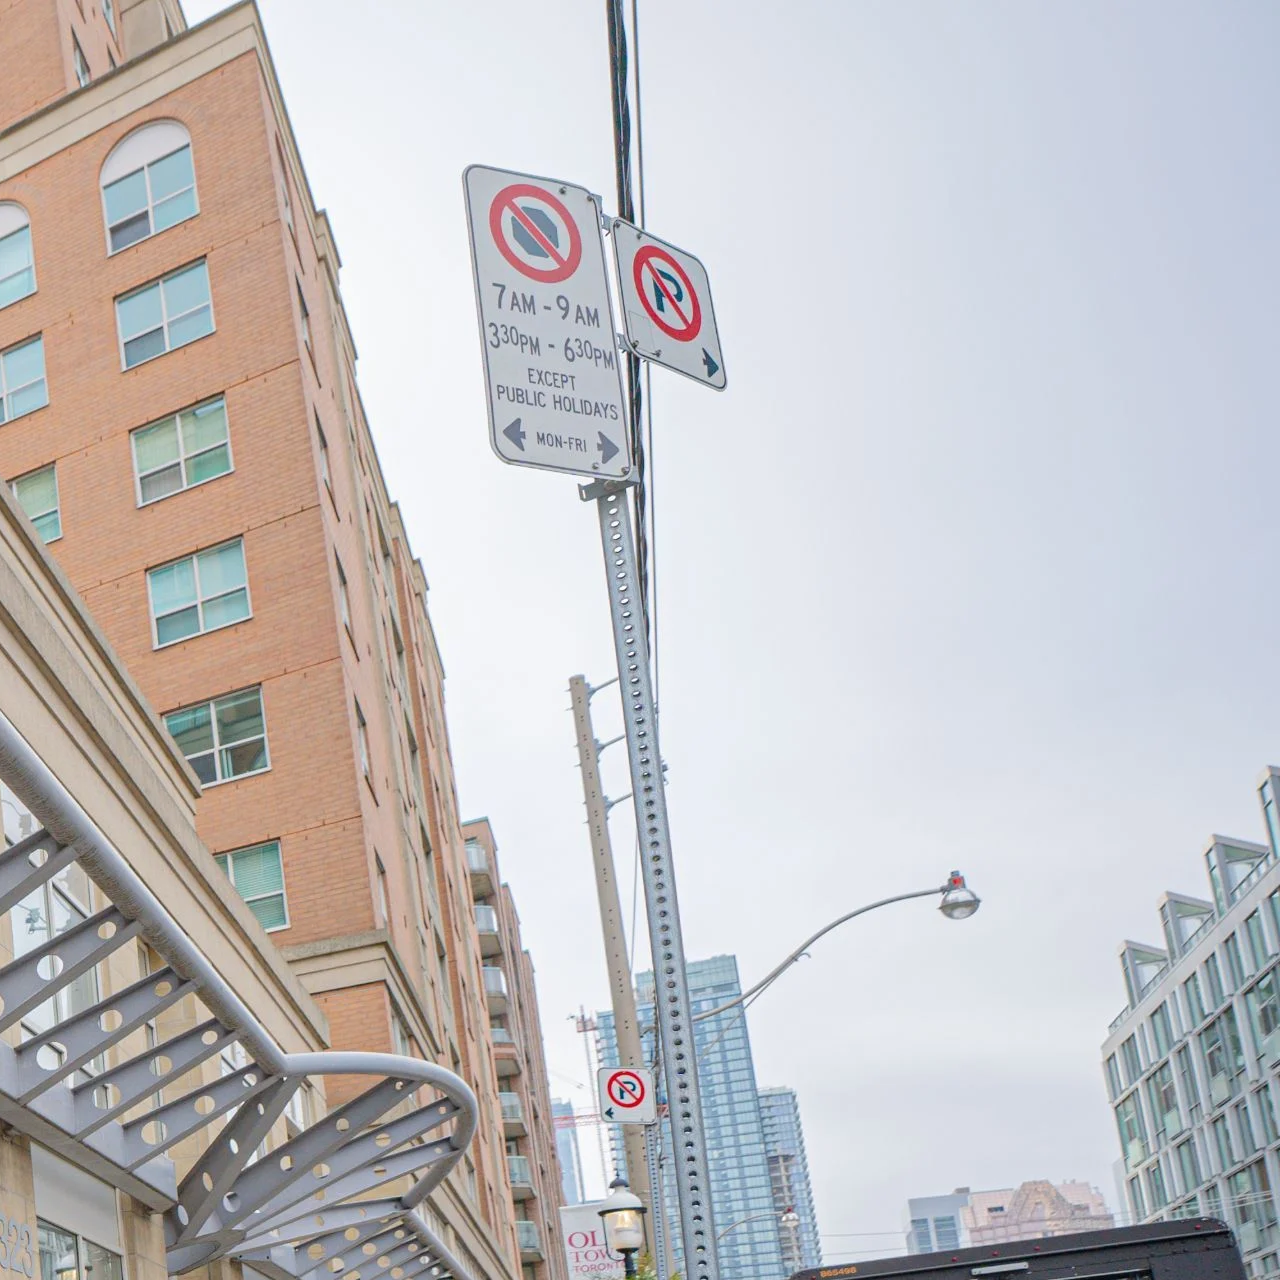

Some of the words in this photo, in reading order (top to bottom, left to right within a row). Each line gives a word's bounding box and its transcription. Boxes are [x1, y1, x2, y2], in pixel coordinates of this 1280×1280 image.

[528, 368, 576, 391] EXCEPT
[497, 384, 546, 408] PUBLIC
[553, 394, 618, 420] HOLIDAYS
[537, 431, 587, 453] MON-FRI
[568, 1231, 607, 1249] OL
